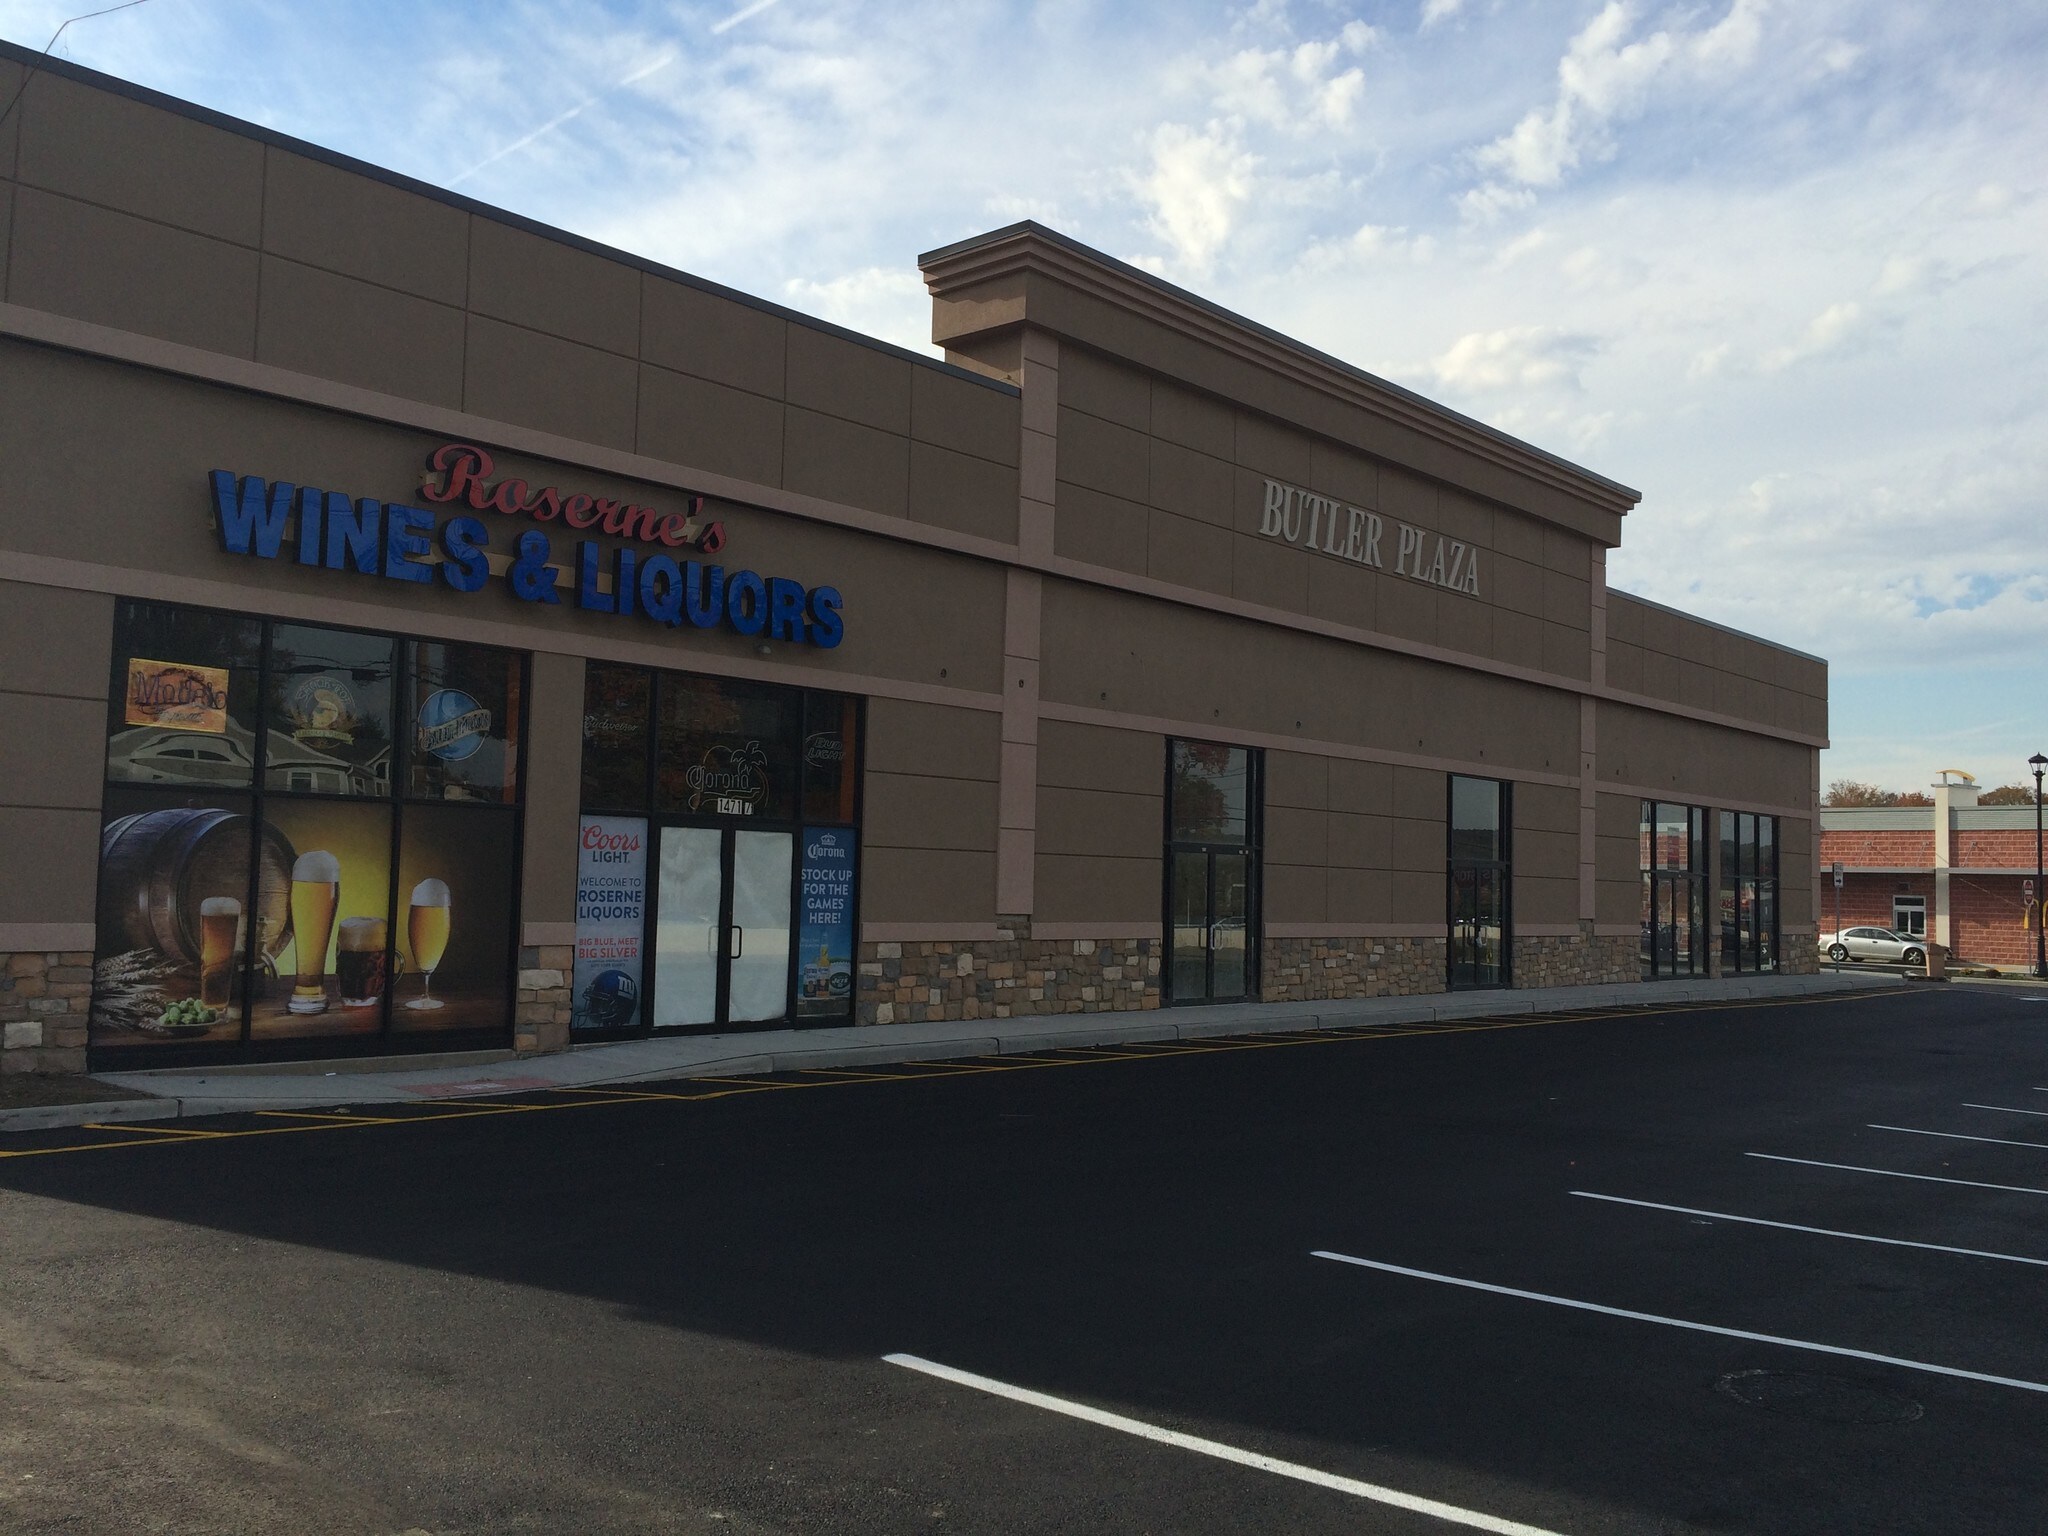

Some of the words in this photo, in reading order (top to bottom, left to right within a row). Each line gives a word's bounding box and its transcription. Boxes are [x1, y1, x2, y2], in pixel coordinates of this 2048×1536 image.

[420, 443, 728, 554] Roserne's
[1258, 479, 1382, 568] BUTLER
[1393, 523, 1480, 596] PLAZA
[208, 469, 491, 593] WINES
[511, 529, 561, 606] &
[576, 540, 846, 650] LIQUORS
[686, 765, 750, 793] Corona
[719, 798, 742, 814] 1471
[583, 825, 640, 851] Coors
[807, 843, 845, 860] Corona
[801, 868, 836, 881] STOCK
[838, 869, 853, 881] UP
[580, 877, 627, 887] WELCOME
[629, 878, 641, 887] TO
[578, 890, 642, 903] ROSERNE
[803, 883, 826, 895] FOR
[828, 884, 849, 896] THE
[807, 897, 844, 910] GAMES
[579, 906, 640, 922] LIQUORS
[809, 912, 841, 924] HERE!
[578, 938, 593, 946] BIG
[617, 937, 639, 946] MEET
[578, 948, 598, 959] BIG
[600, 947, 638, 959] SILVER
